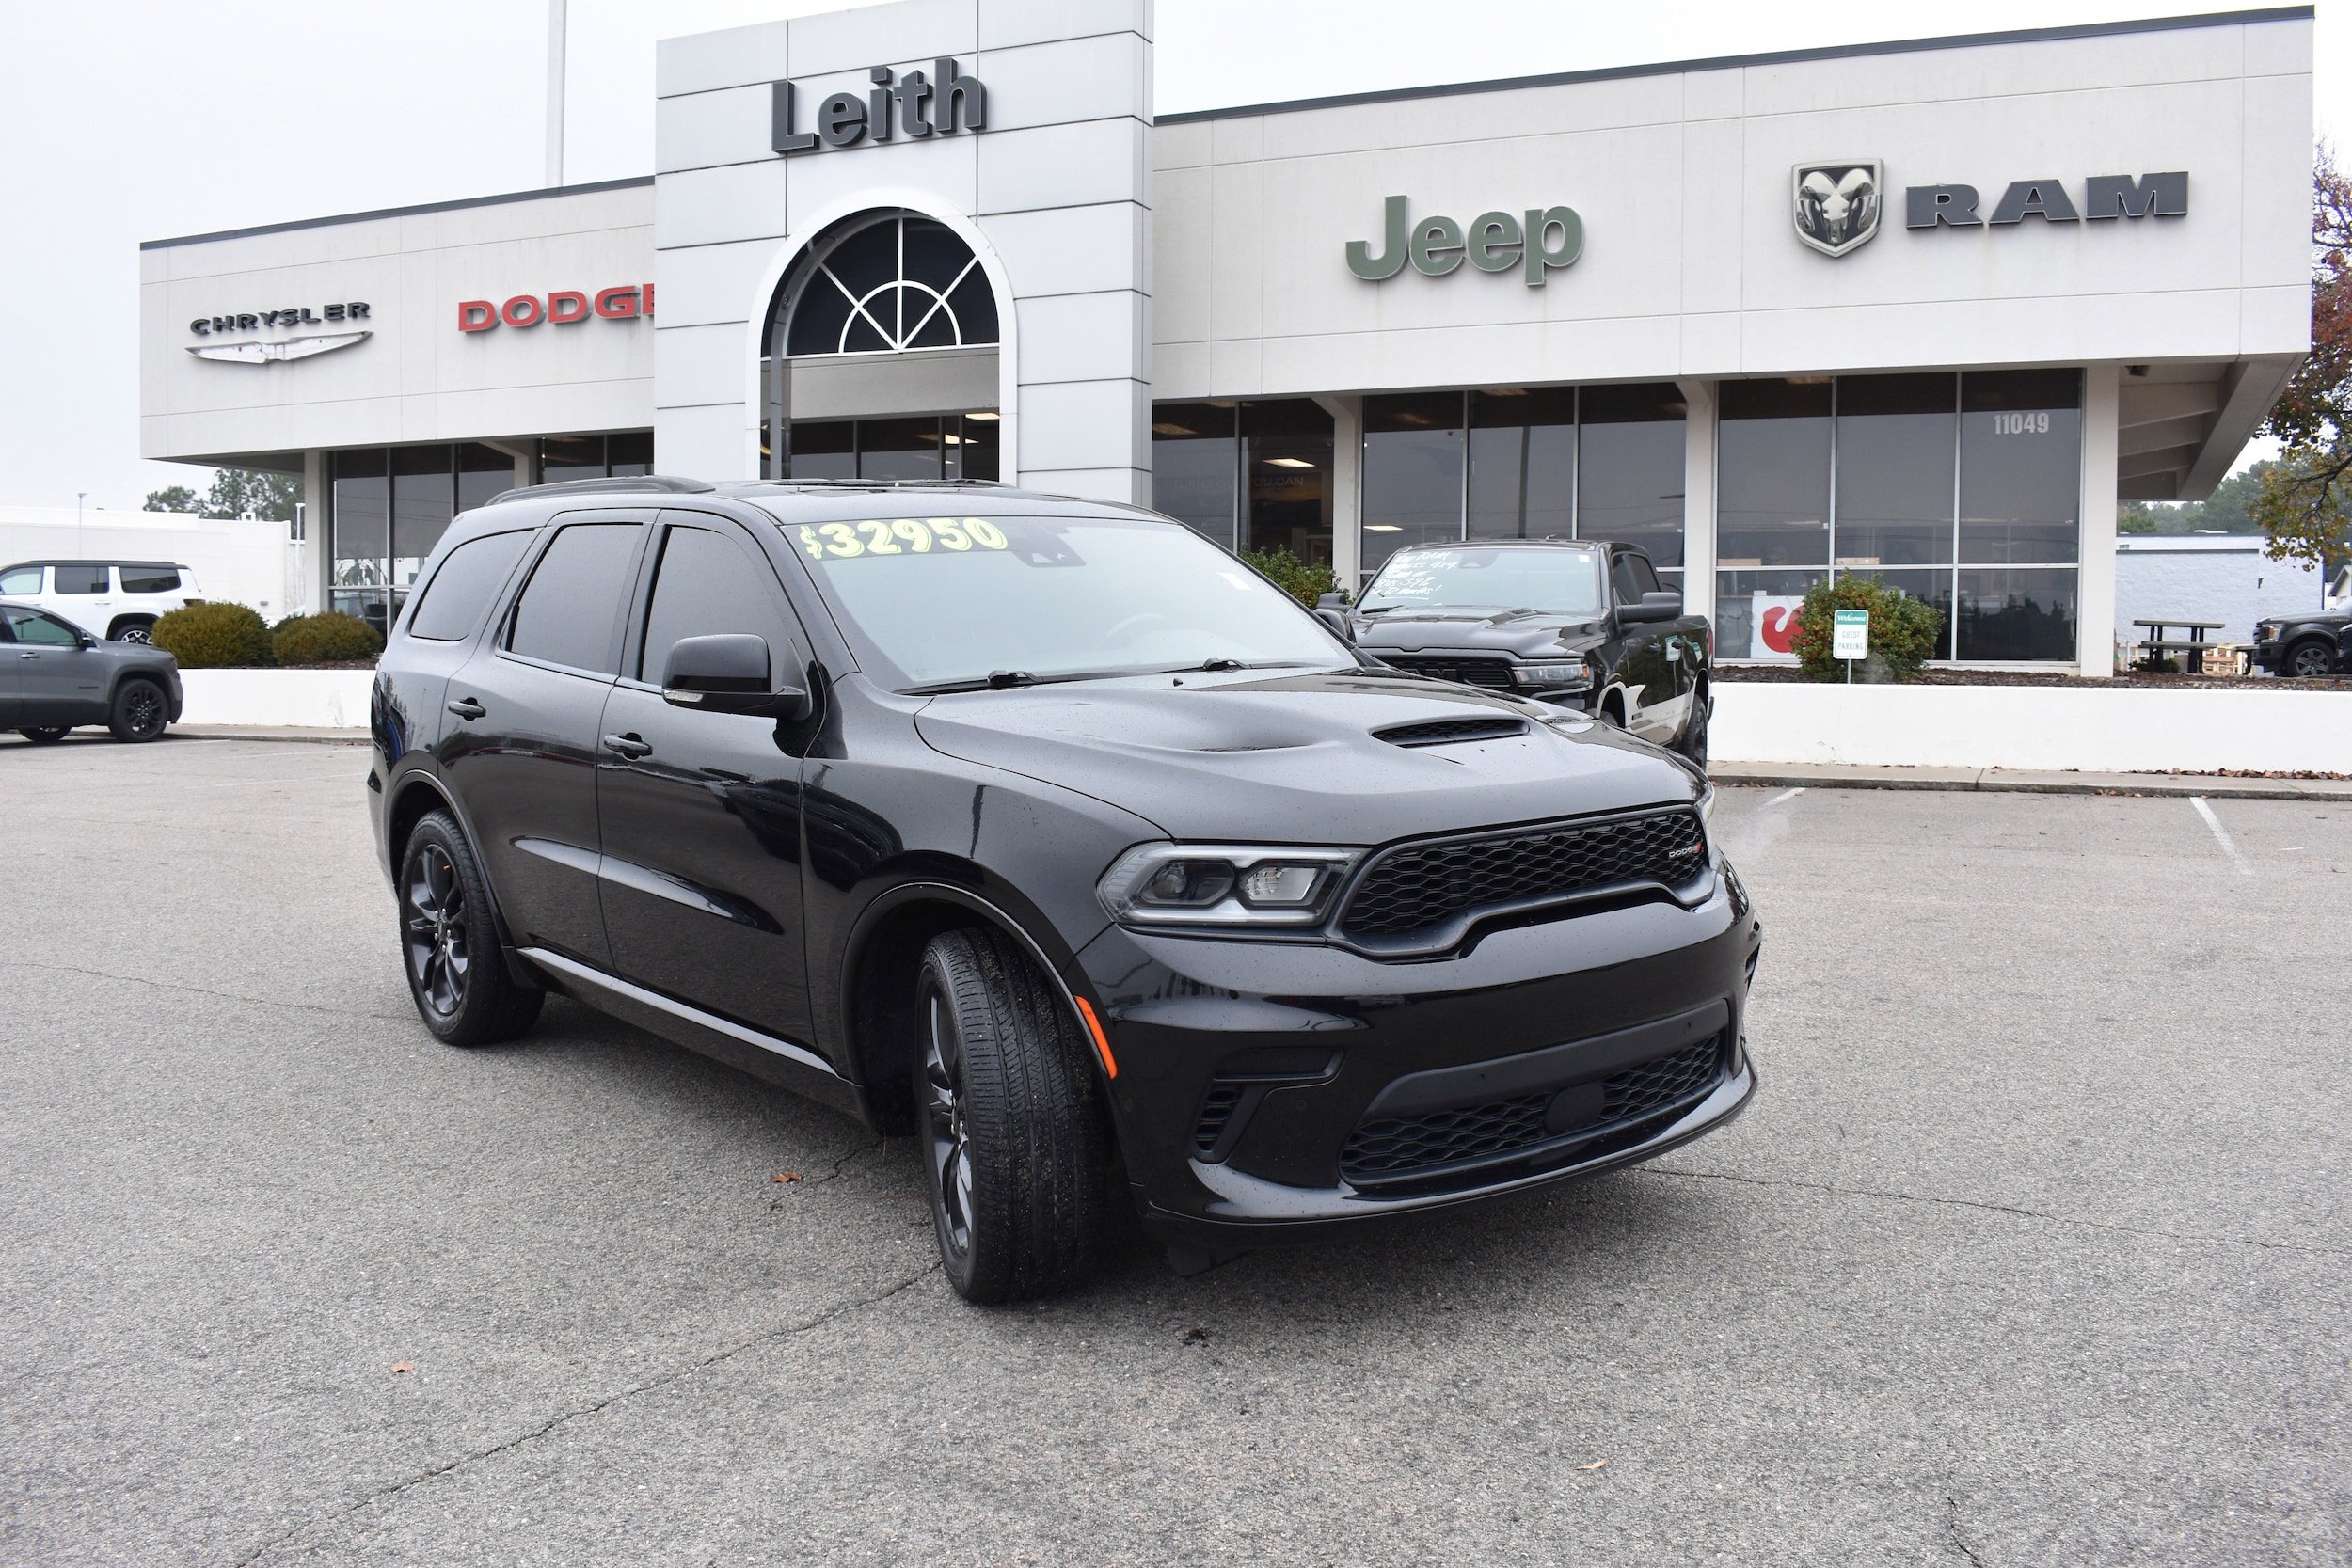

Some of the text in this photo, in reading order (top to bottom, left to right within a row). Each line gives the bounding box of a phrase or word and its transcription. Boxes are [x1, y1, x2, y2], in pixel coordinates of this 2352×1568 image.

[771, 57, 987, 155] Leith
[1906, 171, 2188, 230] RAM
[1345, 195, 1584, 286] Jeep
[189, 302, 371, 336] CHRYSLER
[1994, 412, 2049, 435] 11049
[1275, 476, 1304, 486] CAN
[800, 517, 1008, 560] $32950
[1837, 612, 1867, 622] Welcome
[1841, 630, 1860, 639] GUEST
